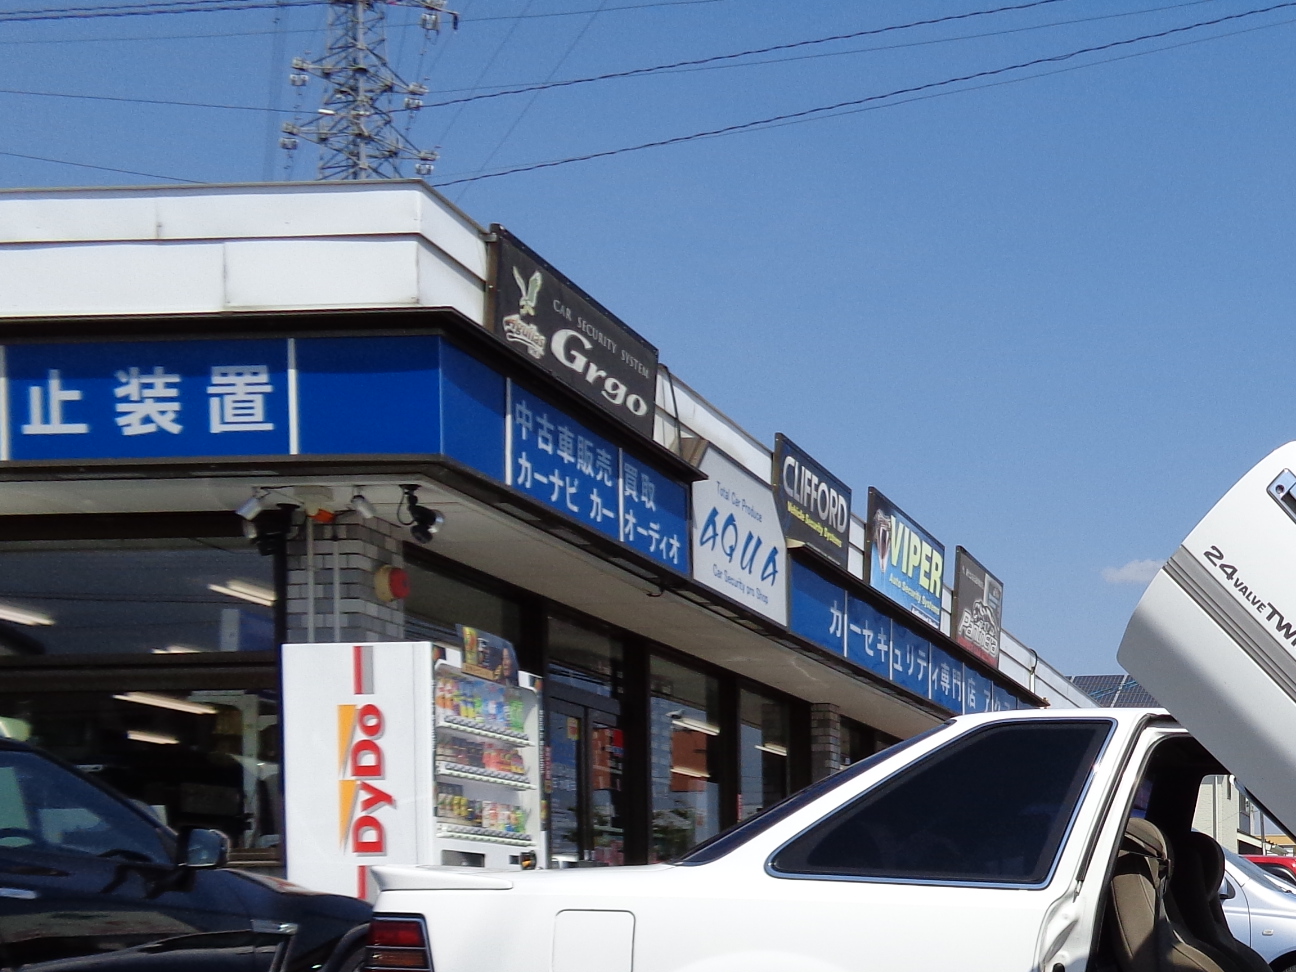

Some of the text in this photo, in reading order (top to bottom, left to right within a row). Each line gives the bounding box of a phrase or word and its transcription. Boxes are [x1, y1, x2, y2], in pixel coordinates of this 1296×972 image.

[551, 328, 648, 416] Grgo
[553, 300, 572, 322] CAR
[577, 317, 617, 354] SECURITY
[621, 349, 649, 379] SYSTEM
[21, 365, 275, 436] 止装置
[517, 451, 580, 513] カーナビ
[782, 455, 848, 534] CLIFFORD
[699, 506, 779, 588] AQUA
[712, 563, 723, 579] Car
[724, 569, 746, 594] Security
[890, 514, 943, 599] VIPER
[1203, 545, 1238, 581] 24
[1233, 577, 1267, 614] VALVE
